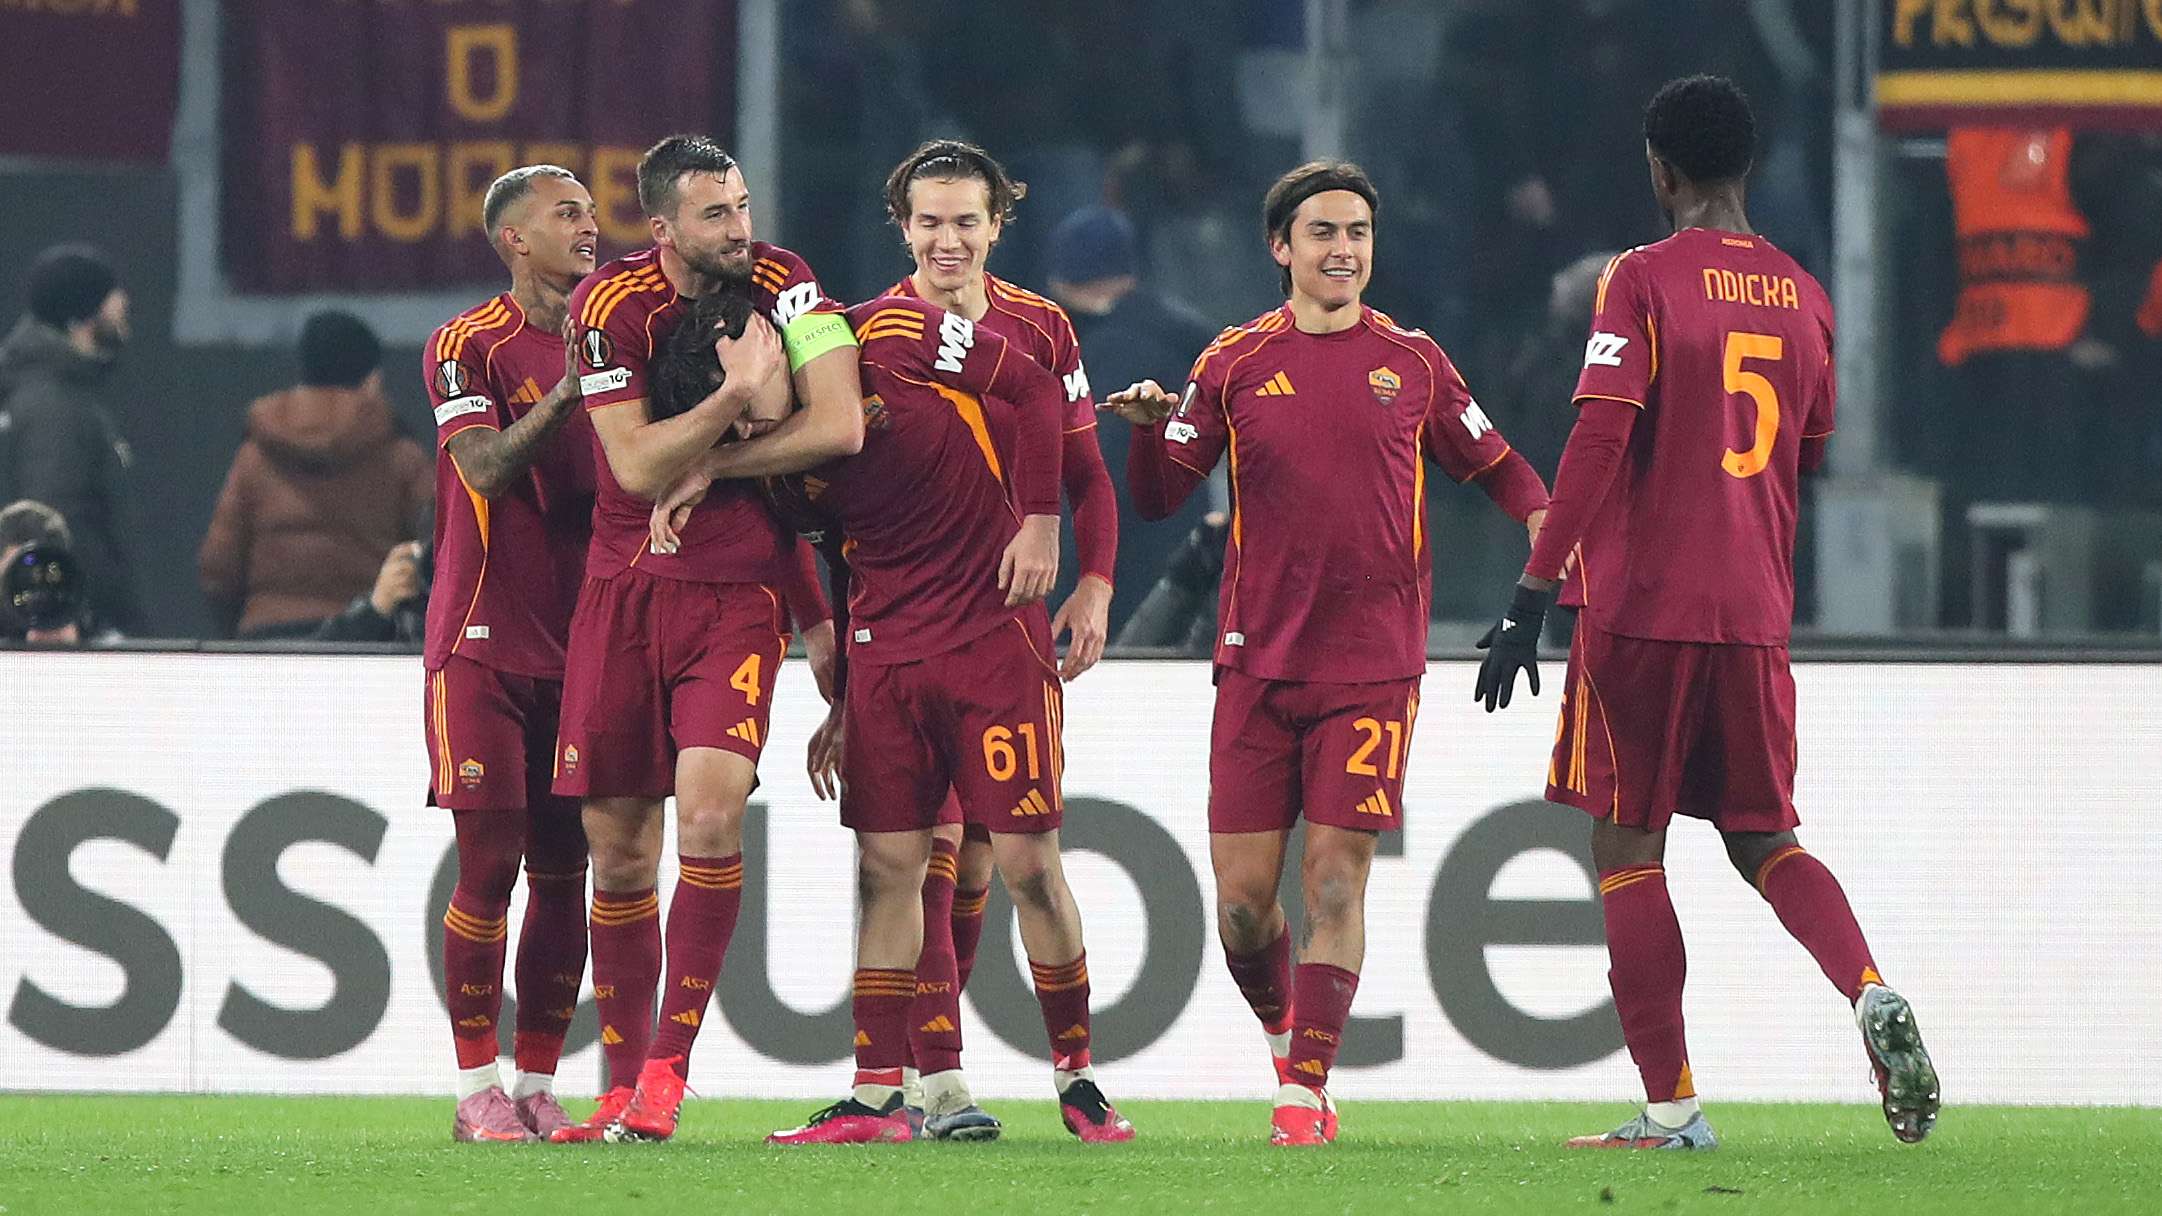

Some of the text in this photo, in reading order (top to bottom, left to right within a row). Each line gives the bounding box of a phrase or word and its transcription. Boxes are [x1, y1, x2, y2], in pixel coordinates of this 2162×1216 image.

[1702, 268, 1799, 310] NDICKA
[804, 322, 842, 342] RESPECT
[1721, 331, 1783, 478] 5
[729, 653, 761, 706] 4
[982, 722, 1040, 781] 61
[1346, 717, 1402, 779] 21
[594, 984, 615, 999] SR
[680, 975, 709, 991] ASR
[916, 982, 951, 994] ASR
